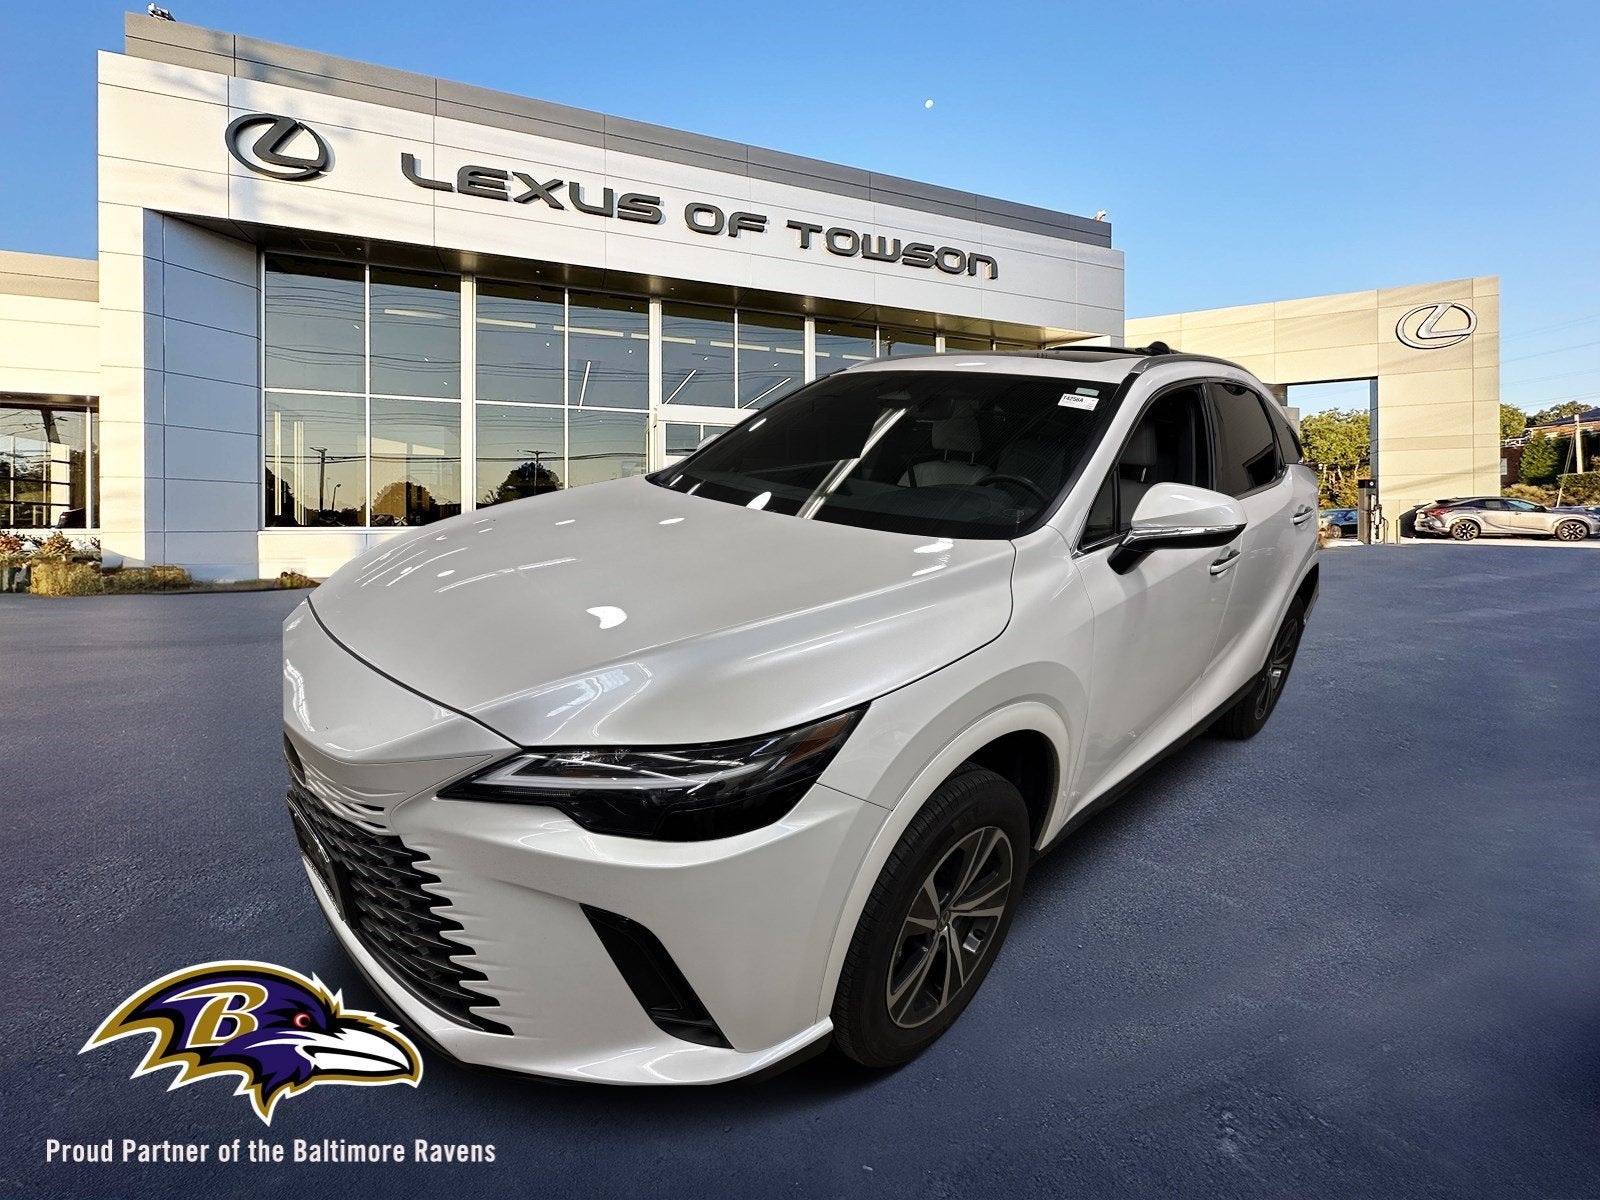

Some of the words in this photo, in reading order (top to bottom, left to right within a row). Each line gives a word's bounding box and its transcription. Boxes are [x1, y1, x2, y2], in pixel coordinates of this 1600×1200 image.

[401, 152, 663, 225] LEXUS
[684, 202, 768, 238] OF
[786, 219, 999, 281] TOWSON
